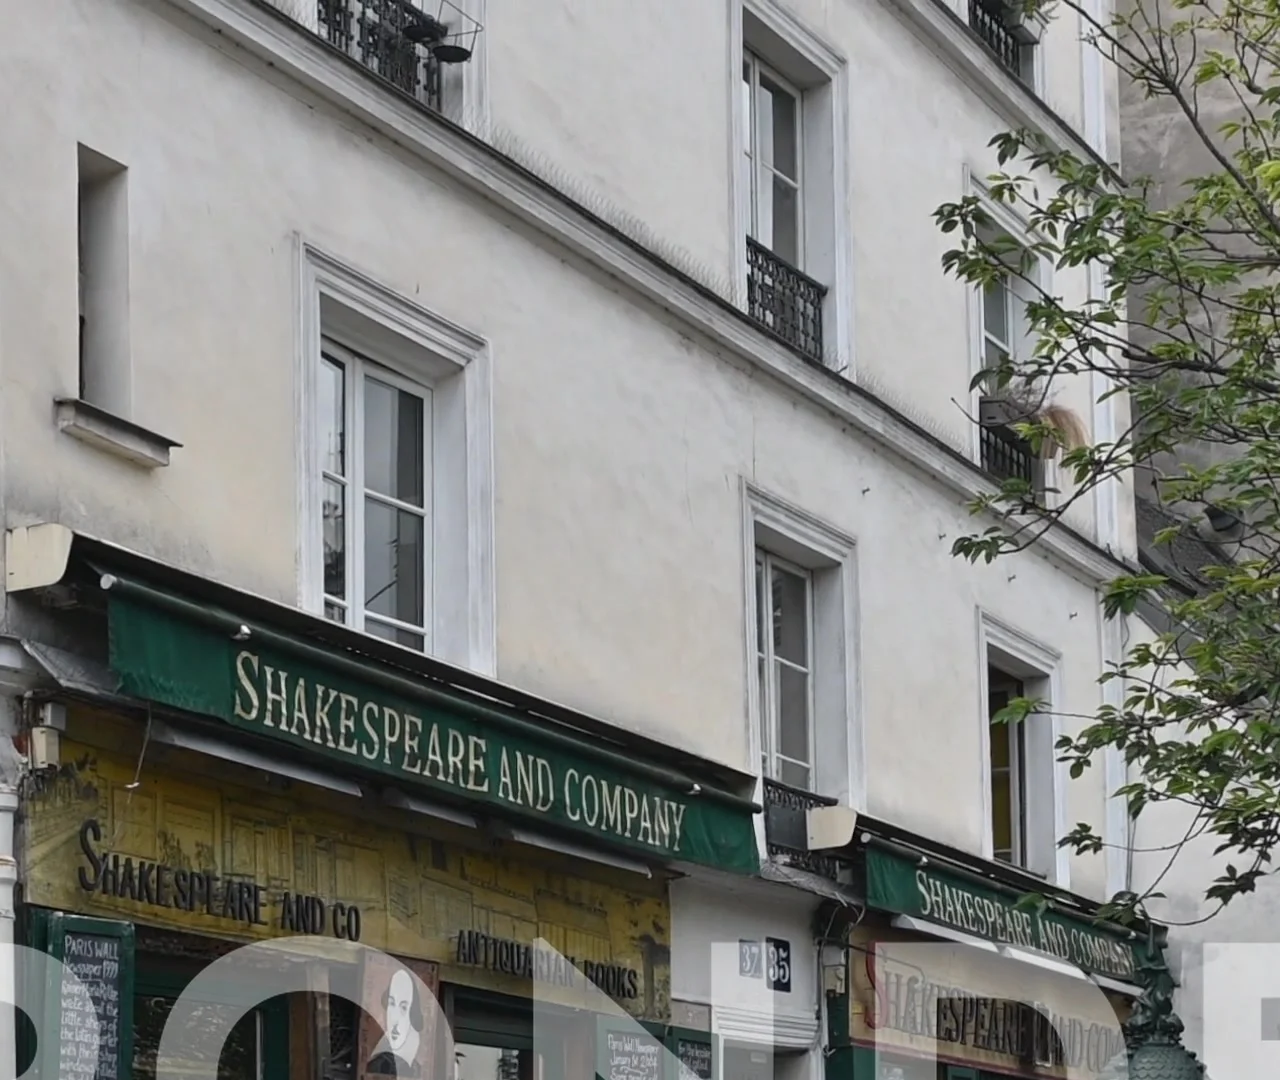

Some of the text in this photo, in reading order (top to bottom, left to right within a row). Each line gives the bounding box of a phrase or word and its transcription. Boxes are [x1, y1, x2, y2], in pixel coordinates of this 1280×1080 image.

[234, 650, 687, 853] SHAKESPEARE AND COMPANY
[78, 818, 361, 943] SHAKESPEARE AND CO
[916, 870, 1135, 976] SHAKESPEARE AND COMPANY
[65, 935, 119, 960] PARIS WALL
[456, 929, 639, 1000] ANTIQUARIAN BOOKS
[768, 945, 790, 984] 35
[864, 940, 1032, 1058] SHAKESPEARE
